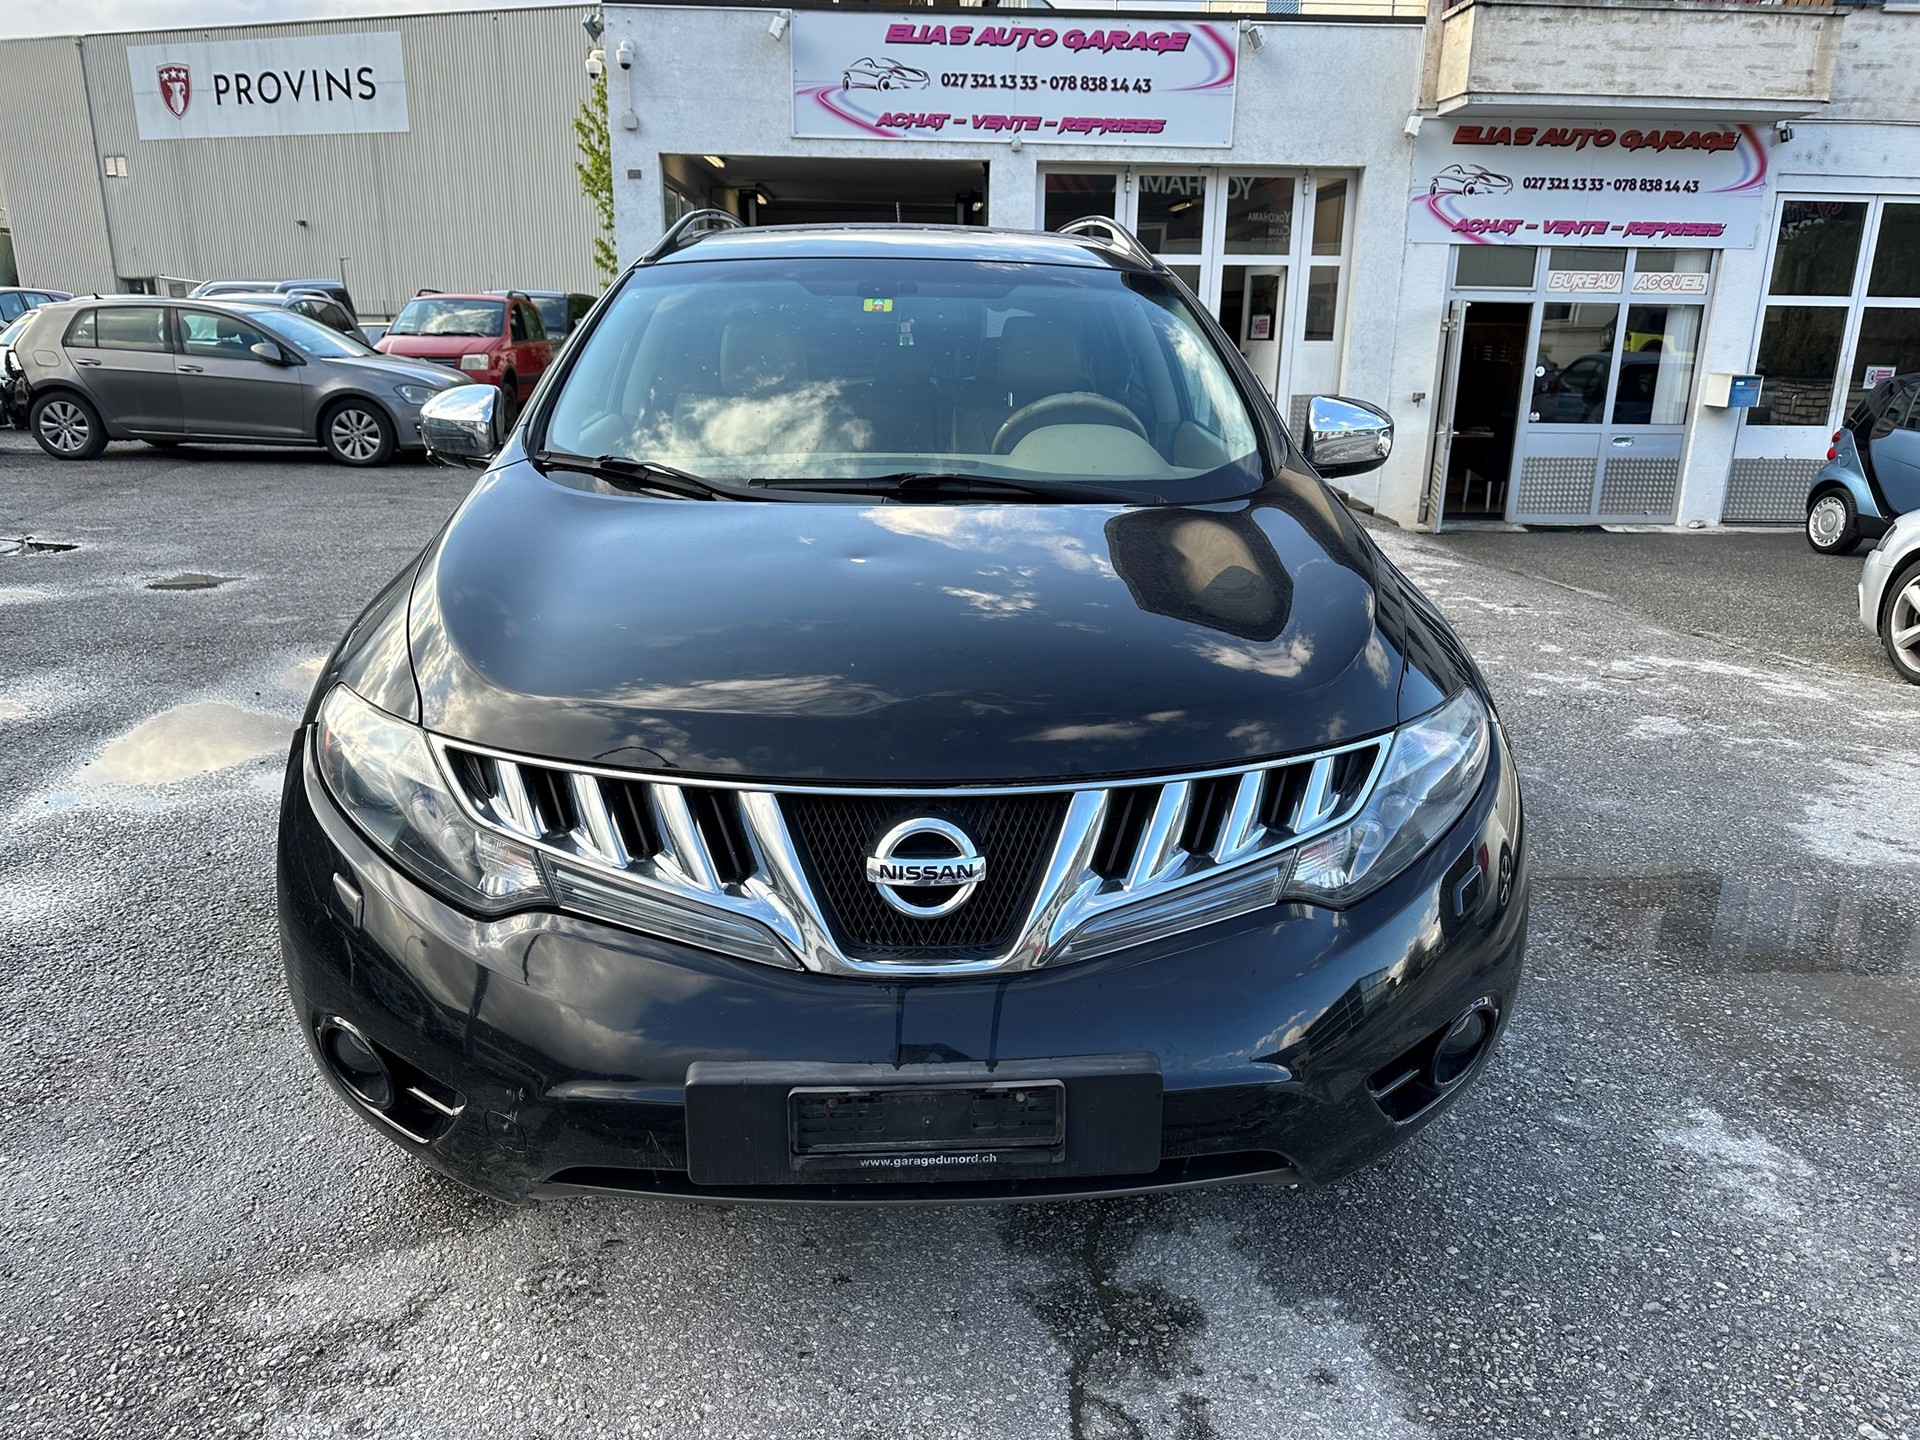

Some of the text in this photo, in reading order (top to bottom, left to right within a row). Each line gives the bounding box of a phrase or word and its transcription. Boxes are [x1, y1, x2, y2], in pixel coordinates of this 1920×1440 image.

[885, 24, 1191, 55] ELIAS AUTO GARAGE
[213, 66, 376, 105] PROVINS
[941, 73, 967, 88] 027
[970, 74, 997, 89] 321
[1000, 75, 1017, 90] 13
[1019, 75, 1038, 91] 33
[1050, 76, 1078, 91] 078
[1080, 76, 1107, 92] 838
[1110, 77, 1129, 92] 14
[1131, 77, 1152, 93] 43
[876, 112, 949, 131] ACHAT
[970, 114, 1041, 133] VENTE
[1058, 117, 1166, 135] REPRISES
[1452, 126, 1742, 154] ELIAS AUTO GARAGE
[1523, 176, 1546, 190] 027
[1548, 177, 1570, 190] 321
[1573, 178, 1587, 190] 13
[1589, 178, 1604, 190] 33
[1614, 179, 1637, 192] 078
[1639, 179, 1663, 192] 838
[1665, 179, 1680, 193] 14
[1682, 179, 1700, 193] 43
[1451, 218, 1523, 235] ACHAT
[1542, 220, 1611, 237] VENTE
[1622, 221, 1727, 239] REPRISES
[1549, 272, 1622, 291] BUREAU
[1634, 274, 1707, 291] ACCUEL
[880, 864, 973, 880] NISSAN
[860, 1154, 997, 1168] www.garagedunord.ch
